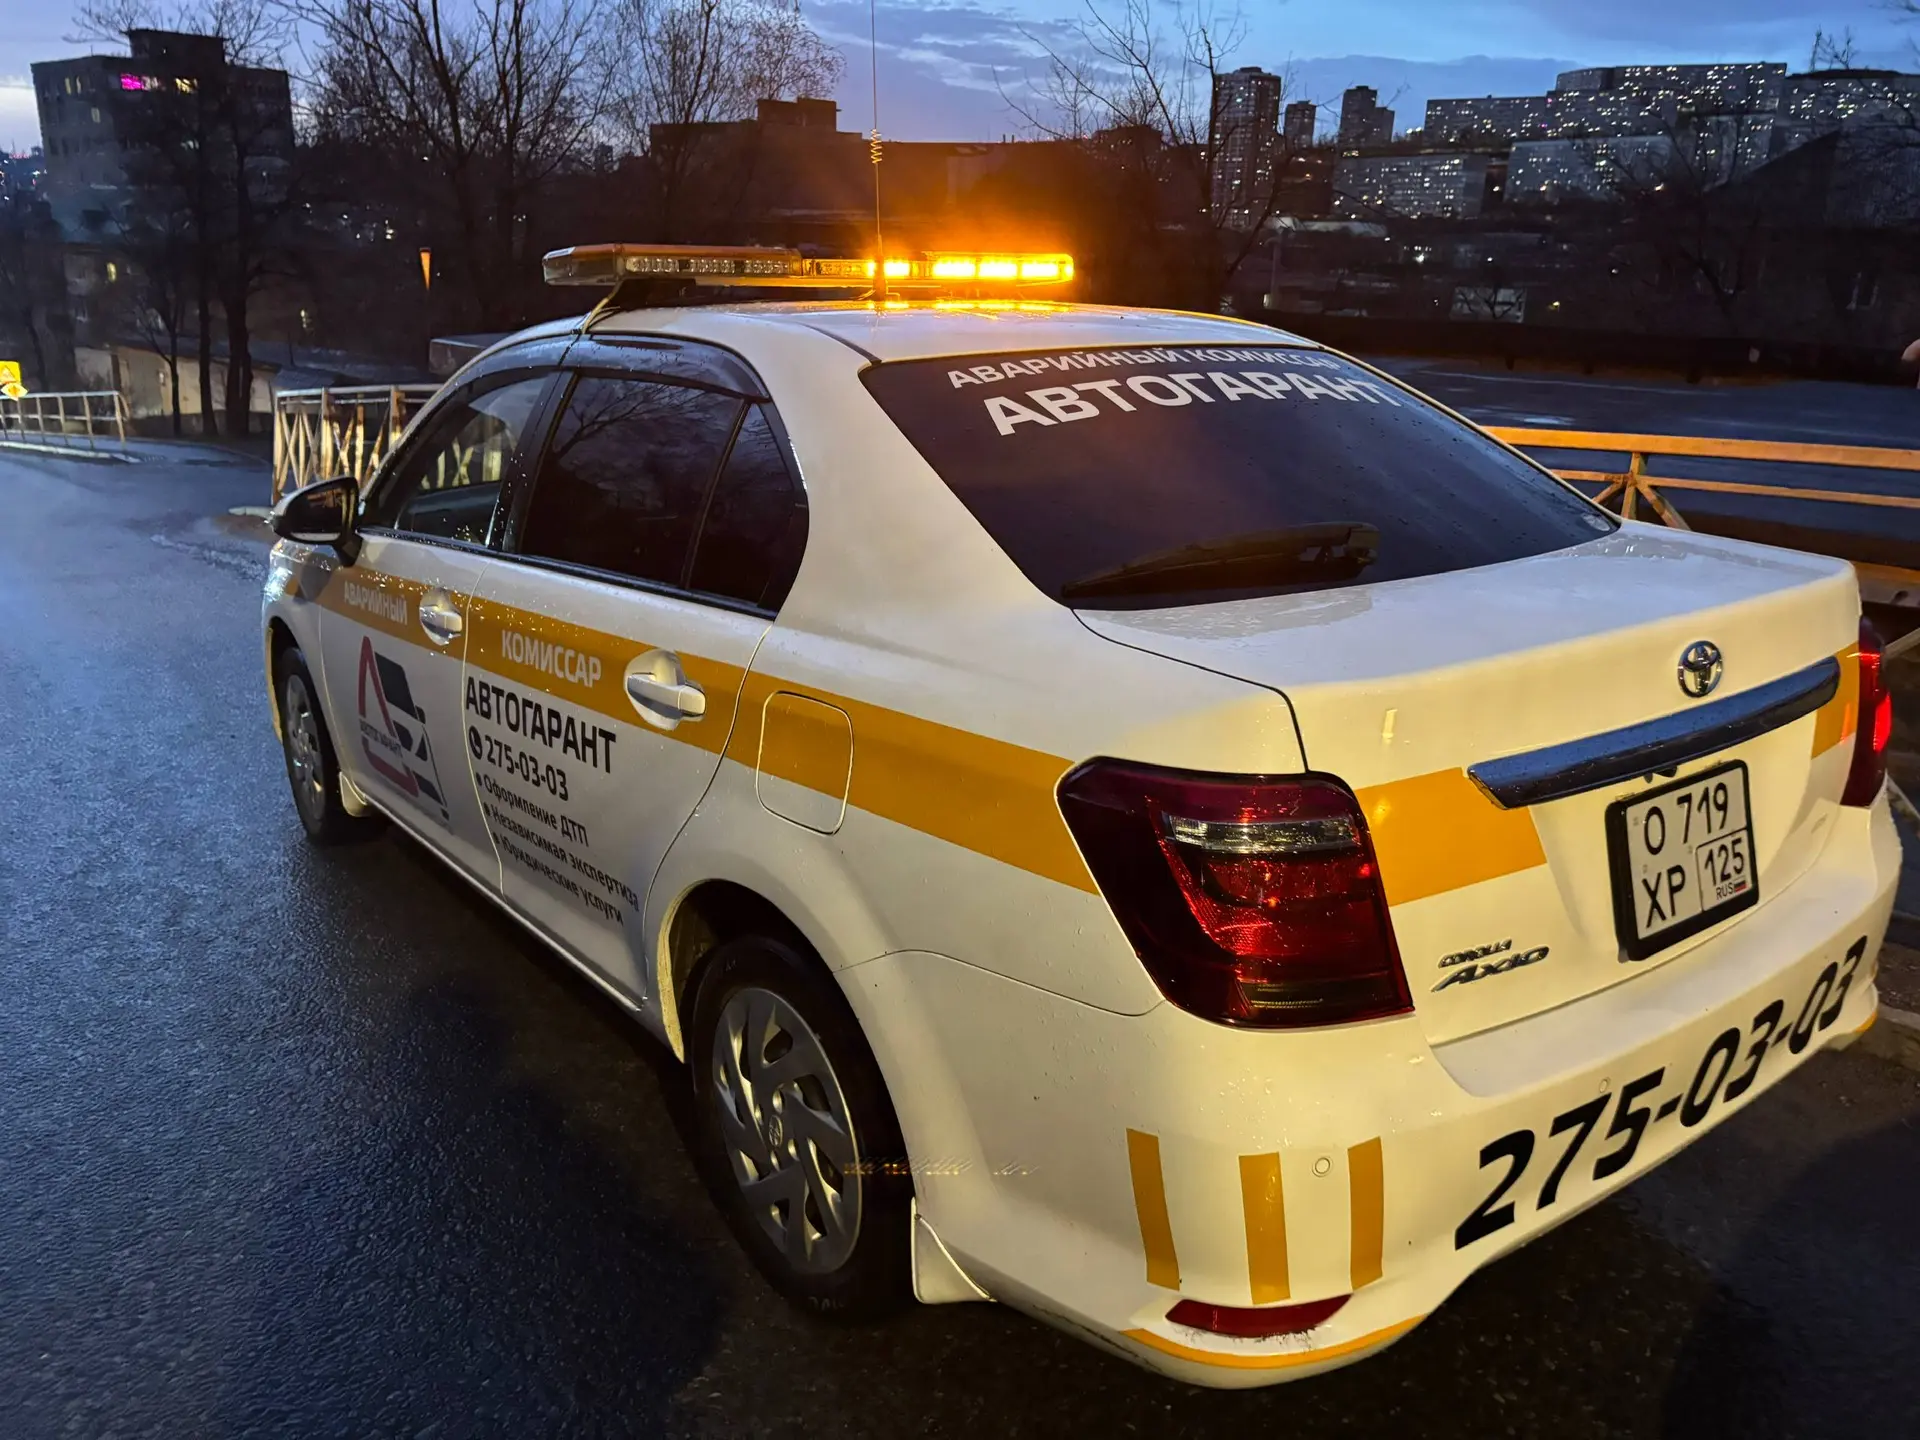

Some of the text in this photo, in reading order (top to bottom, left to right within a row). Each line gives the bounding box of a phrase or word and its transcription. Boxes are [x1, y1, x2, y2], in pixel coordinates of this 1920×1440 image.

[947, 347, 1341, 389] АВАРИЙНЫЙ КОМИССАР
[983, 371, 1402, 436] АВТОГАРАНТ
[343, 579, 602, 689] АВАРИЙНЫЙ КОМИССАР
[466, 676, 617, 774] АВТОГАРАНТ
[484, 734, 569, 801] 275-03-03
[483, 773, 590, 848] Оформление ДТП
[1677, 781, 1729, 845] 719
[489, 803, 640, 913] Независимая экспертиза
[500, 833, 624, 927] Юридические услуги
[1704, 837, 1745, 887] 125
[1716, 882, 1735, 900] RUS
[1454, 934, 1868, 1251] 275-03-03
